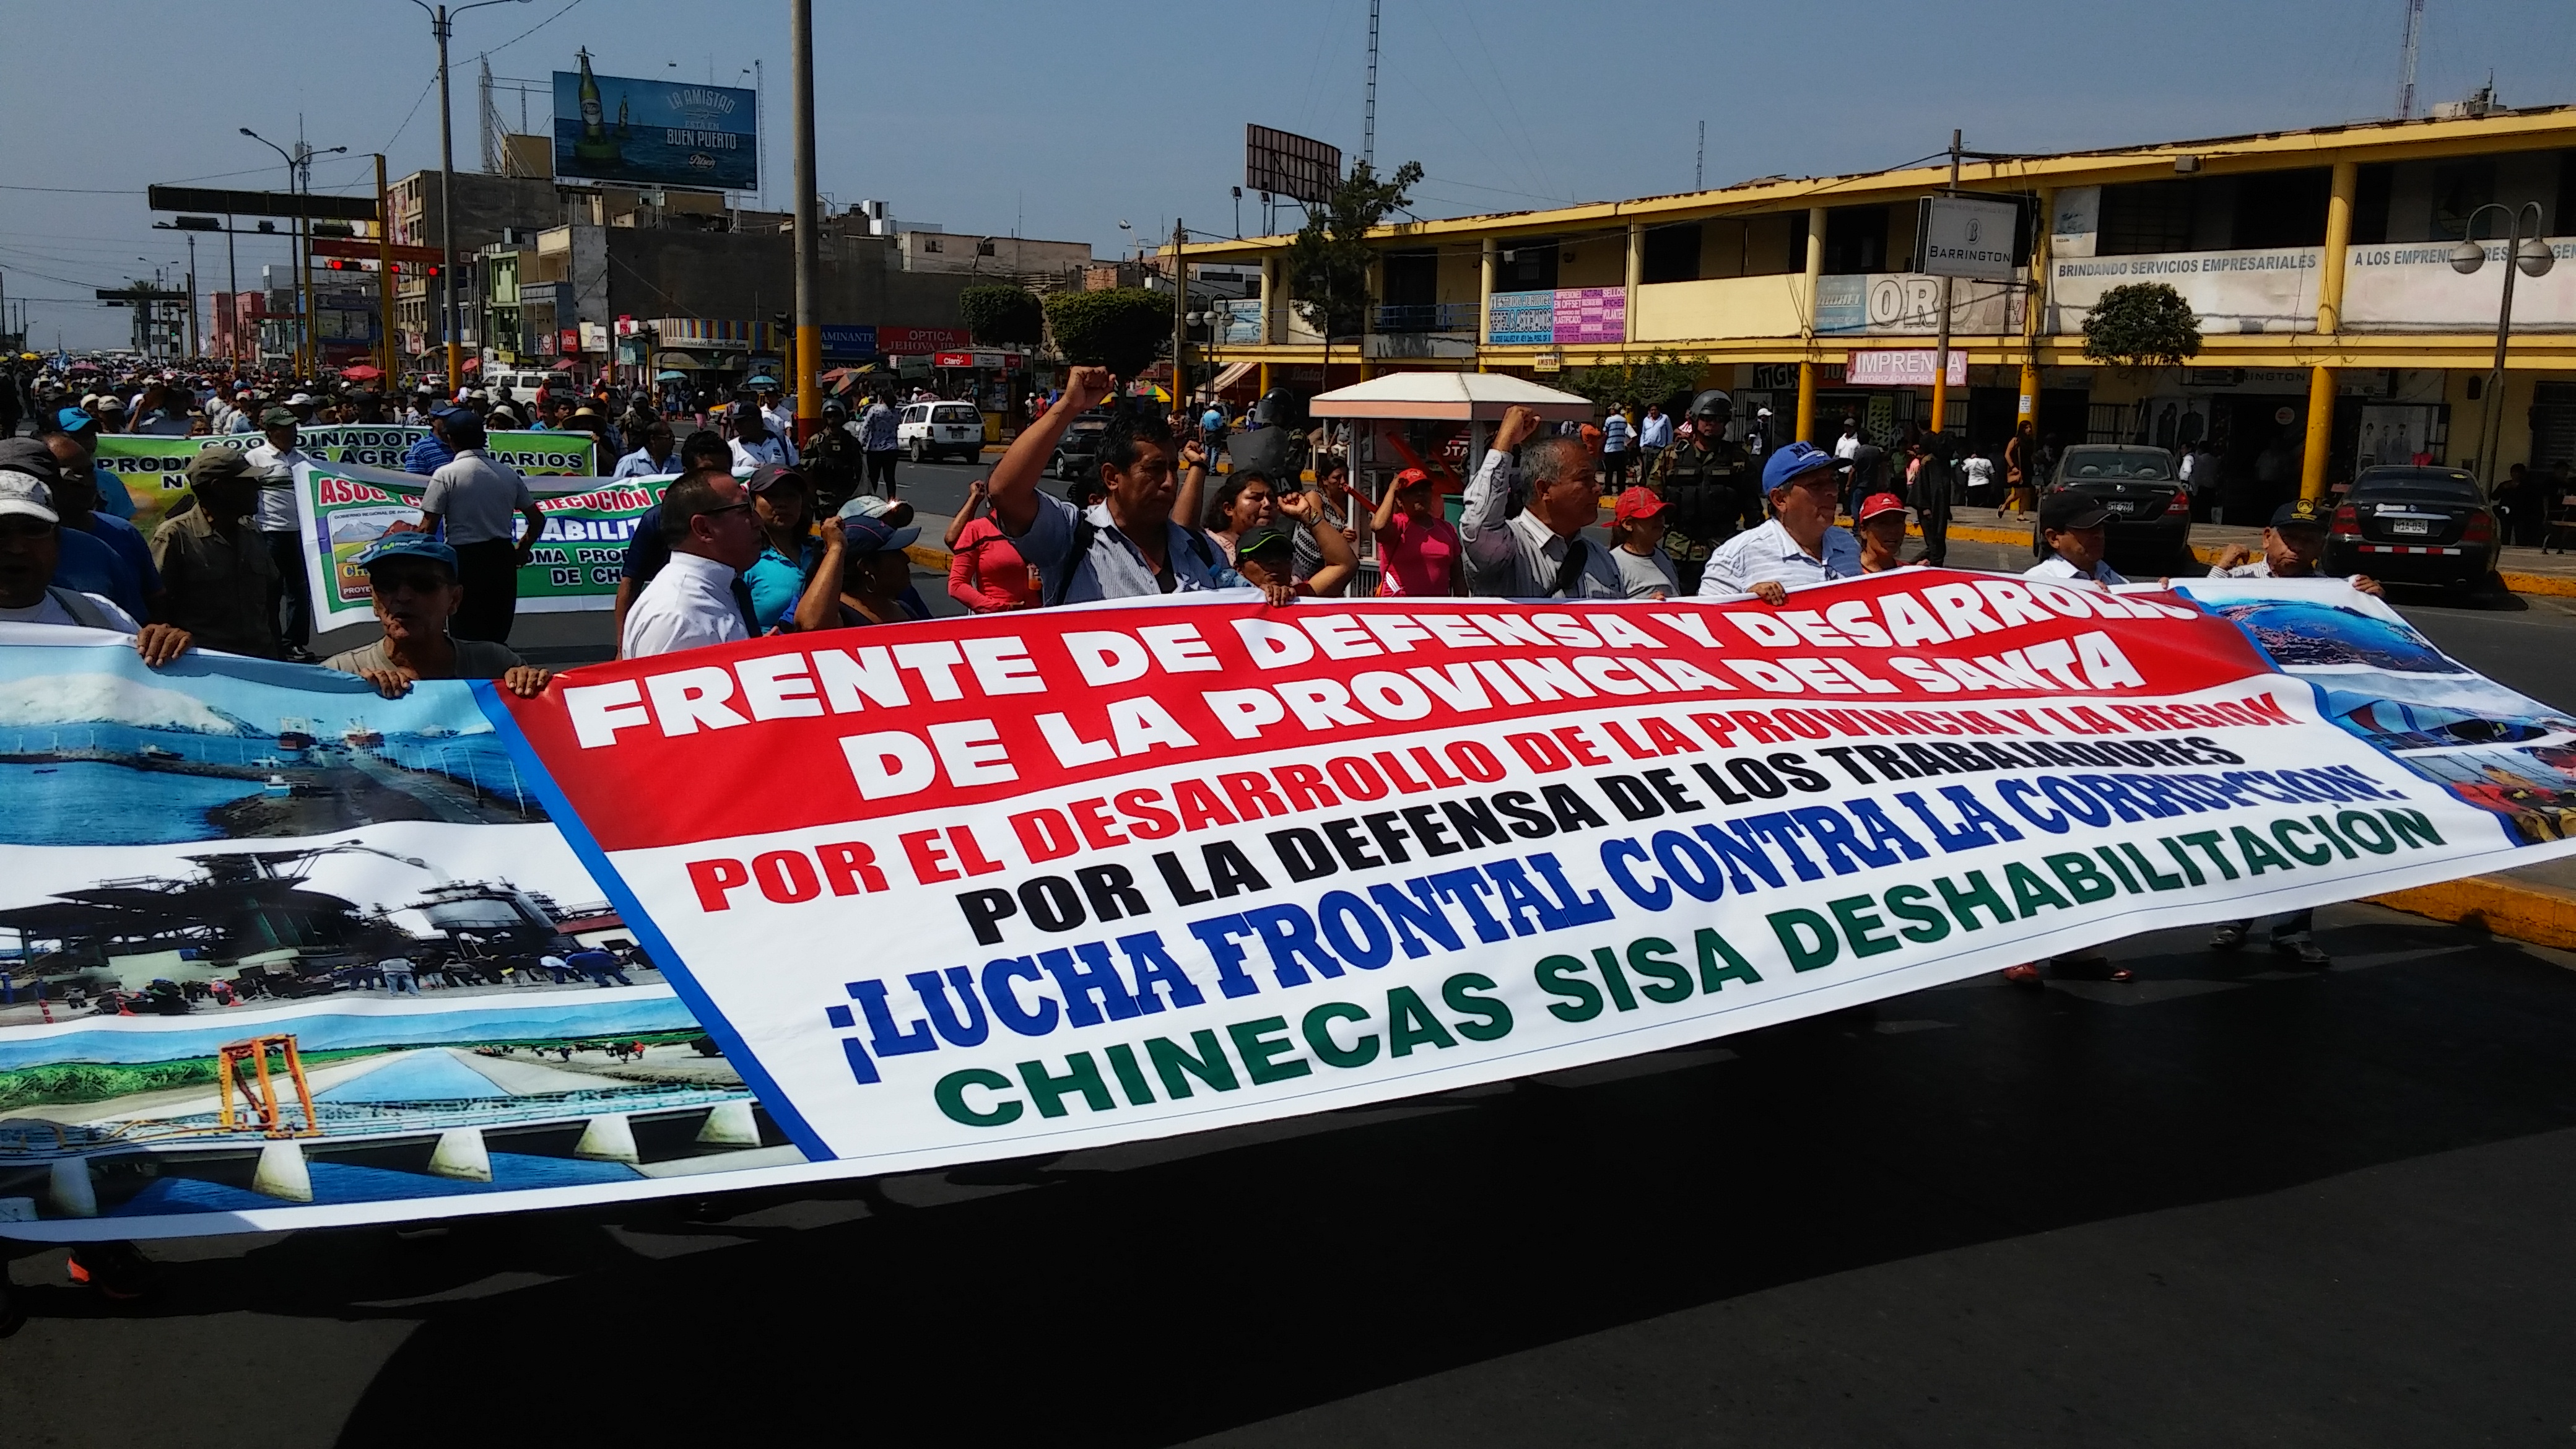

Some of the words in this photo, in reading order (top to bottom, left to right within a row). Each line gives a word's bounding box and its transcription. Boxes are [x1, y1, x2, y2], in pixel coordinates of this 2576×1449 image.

[667, 92, 684, 110] LA
[684, 89, 736, 114] AMISTAD
[667, 128, 694, 146] BUEN
[697, 131, 736, 149] PUERTO
[1930, 246, 2011, 262] BARRINGTON
[2354, 252, 2363, 266] A
[2366, 251, 2390, 265] LOS
[2394, 247, 2508, 264] EMPRENRES
[2058, 262, 2128, 277] BRINDANDO
[2131, 259, 2198, 274] SERVICIOS
[2202, 254, 2316, 272] EMPRESARIALES
[1603, 288, 1625, 297] SELLOS
[1562, 300, 1581, 309] OFFSET
[1516, 308, 1552, 333] ASOCIADOS
[821, 331, 875, 342] AMINANTE
[889, 341, 936, 350] JEHOVA
[908, 329, 954, 342] OPTICA
[944, 357, 961, 365] Claro
[1856, 352, 1962, 373] IMPRENA
[1852, 375, 1908, 383] AUTORIZADA
[321, 479, 394, 504] ASOC.
[552, 570, 581, 584] DE
[343, 586, 370, 594] PROYE
[563, 636, 1048, 749] FRENTE
[1060, 622, 1222, 688] DE
[1230, 613, 1670, 671] DEFENSA
[1647, 612, 1726, 648] Y
[1722, 580, 2199, 648] DESARROLLO
[838, 718, 1020, 801] DE
[1033, 695, 1201, 770] LA
[1200, 655, 1740, 741] PROVINCIA
[1720, 657, 1902, 695] DEL
[1887, 630, 2147, 694] SANTA
[685, 842, 890, 913] POR
[898, 825, 1006, 886] EL
[1007, 741, 1507, 864] DESARROLLO
[1503, 725, 1611, 775] DE
[1599, 716, 1694, 760] LA
[1686, 707, 2012, 747] PROVINCIA
[1993, 709, 2056, 736] Y
[2038, 705, 2119, 735] LA
[2115, 692, 2306, 733] REGION
[955, 863, 1152, 947] POR
[1151, 840, 1271, 907] LA
[1265, 783, 1609, 883] DEFENSA
[1594, 767, 1707, 822] DE
[1690, 743, 1831, 805] LOS
[1815, 736, 2246, 785] TRABAJADORES
[825, 930, 1206, 1086] ¡LUCHA
[1187, 851, 1616, 999] FRONTAL
[1600, 796, 1930, 912] CONTRA
[1905, 784, 2026, 853] LA
[934, 972, 1513, 1128] CHINECAS
[1533, 927, 1764, 1023] SISA
[1765, 803, 2448, 974] DESHABILITACIÓN
